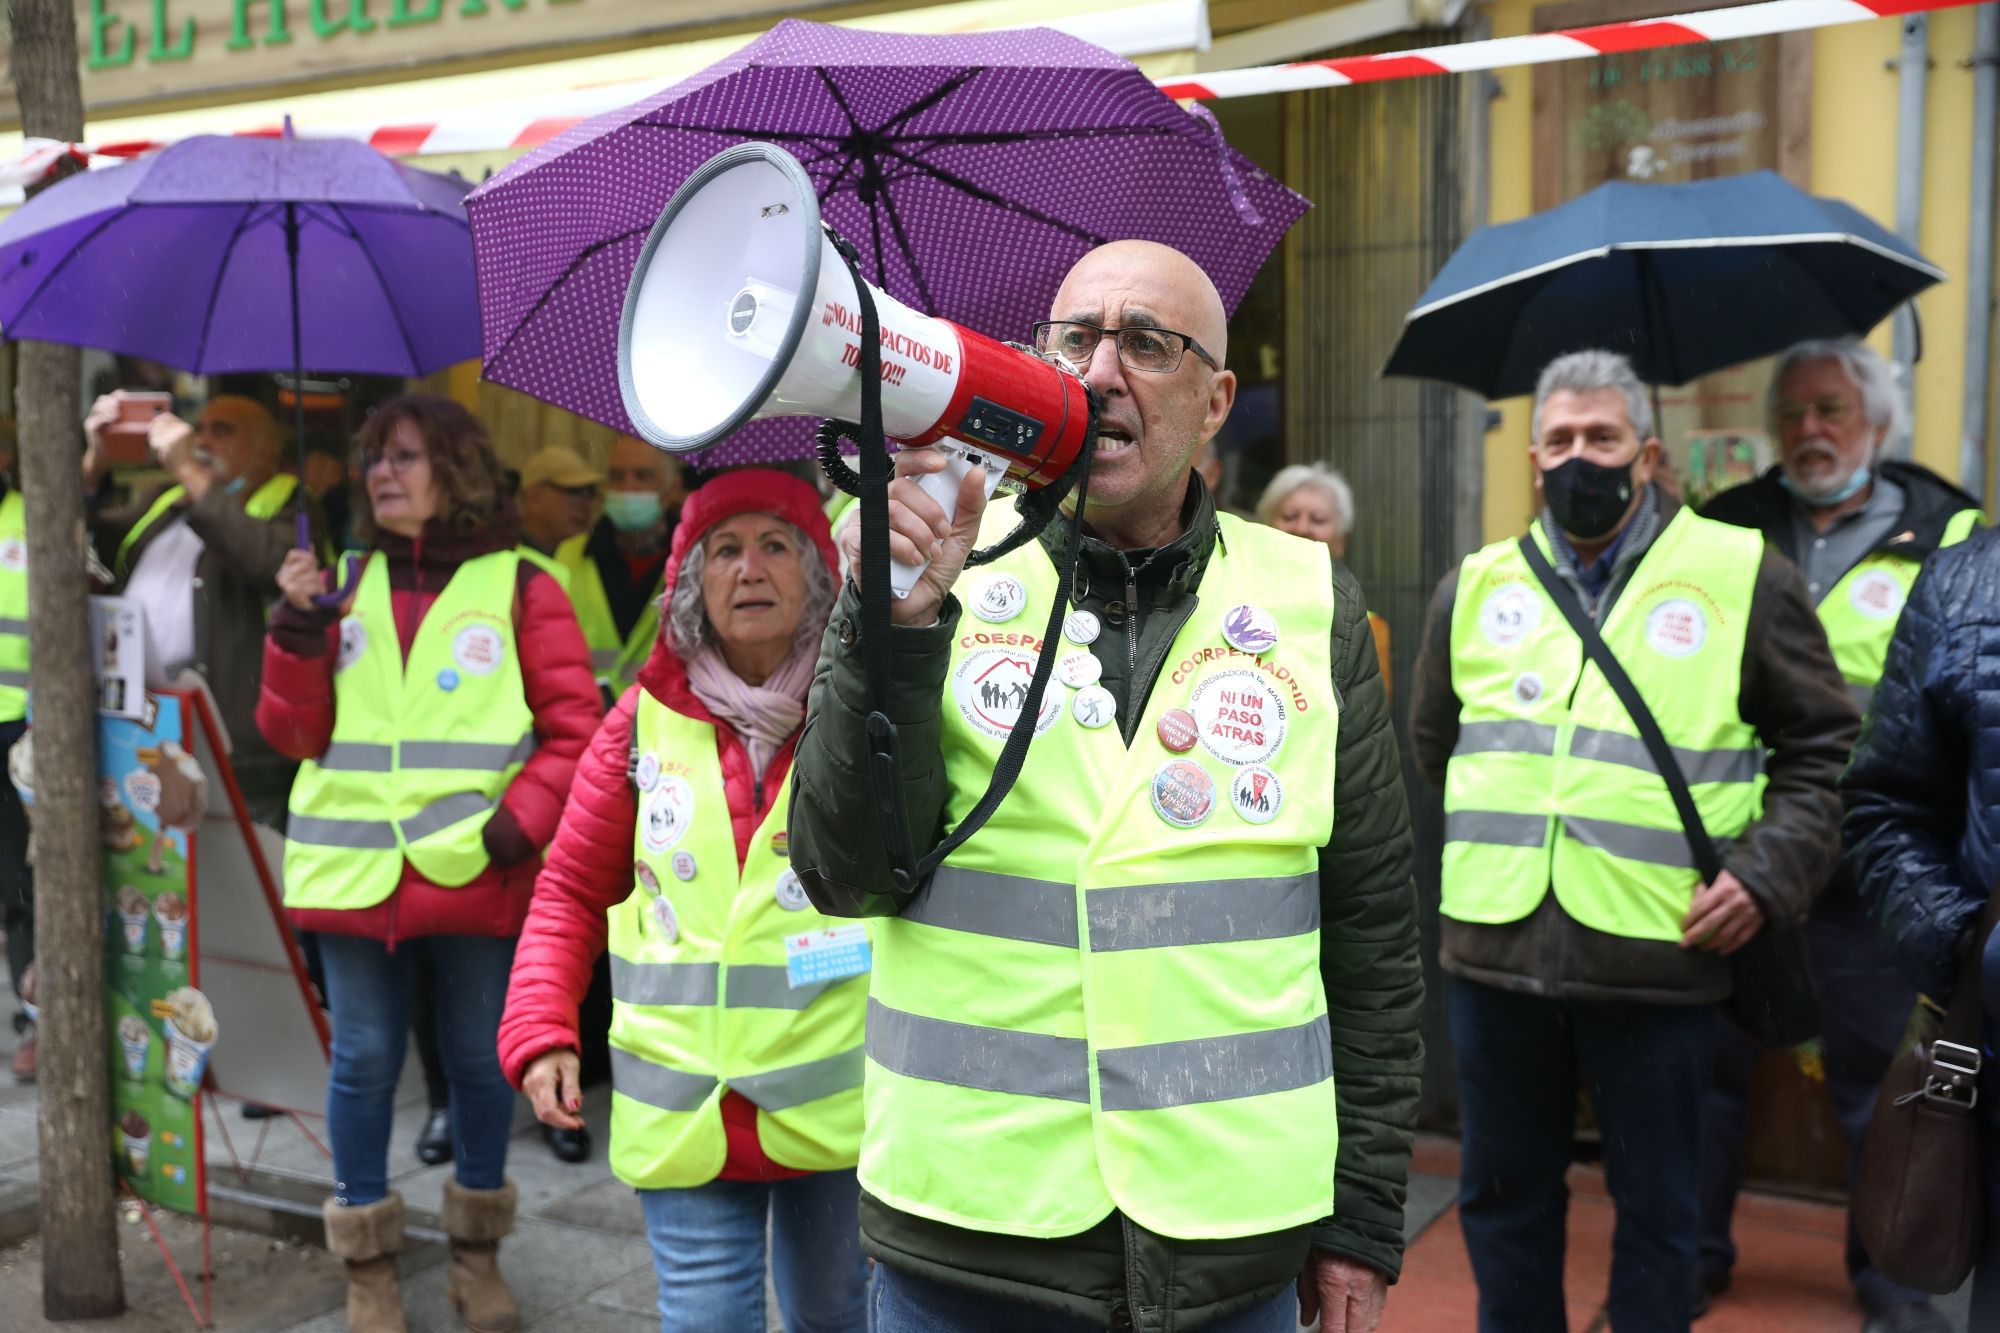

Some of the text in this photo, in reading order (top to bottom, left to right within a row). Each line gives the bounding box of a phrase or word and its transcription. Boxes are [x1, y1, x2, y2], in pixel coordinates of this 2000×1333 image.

[880, 326, 953, 375] PACTOS DE
[1220, 690, 1263, 710] NI UN
[1266, 687, 1286, 720] MADRID
[1217, 707, 1262, 726] PASO
[1211, 723, 1264, 746] ATRAS
